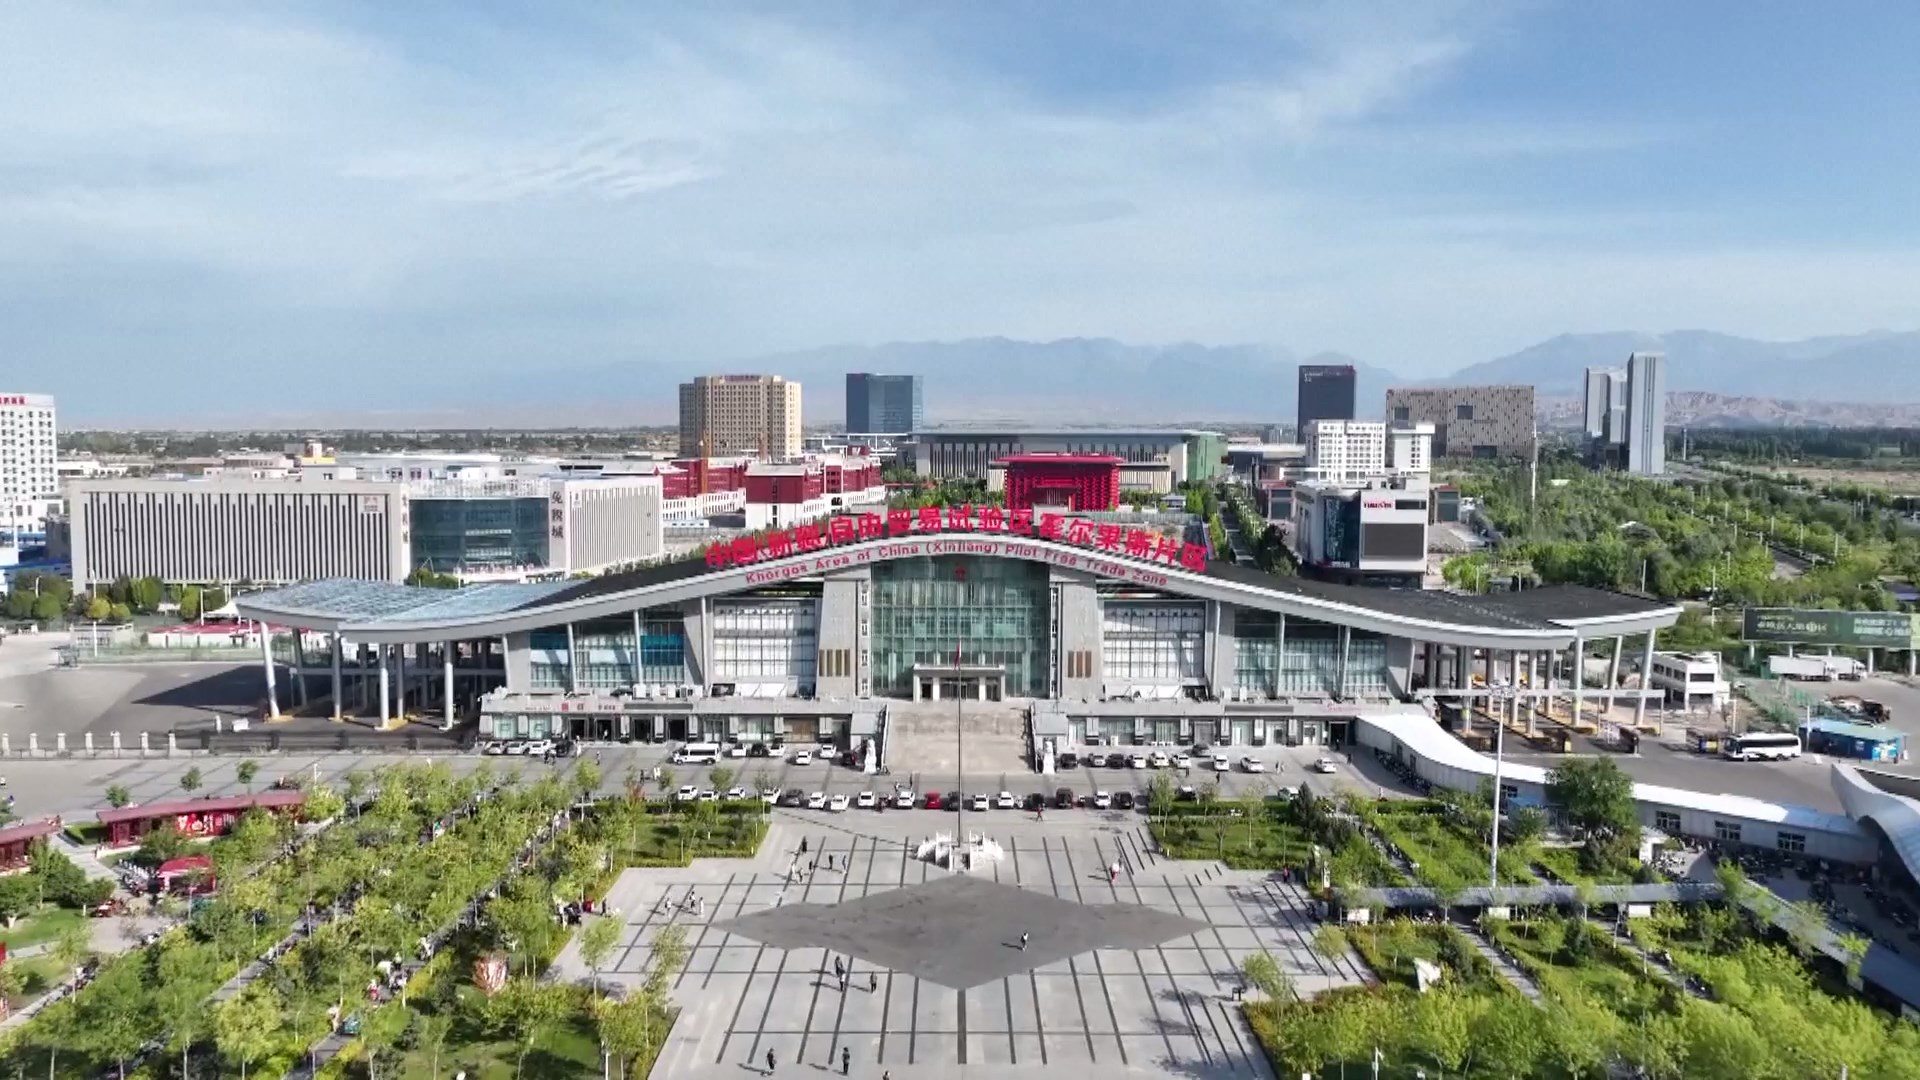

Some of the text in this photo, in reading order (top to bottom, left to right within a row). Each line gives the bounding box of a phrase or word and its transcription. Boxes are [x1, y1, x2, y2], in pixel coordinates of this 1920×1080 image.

[746, 541, 1169, 586] Khorgos Area of China (Xinjiang) Pilot Free Trade Zone
